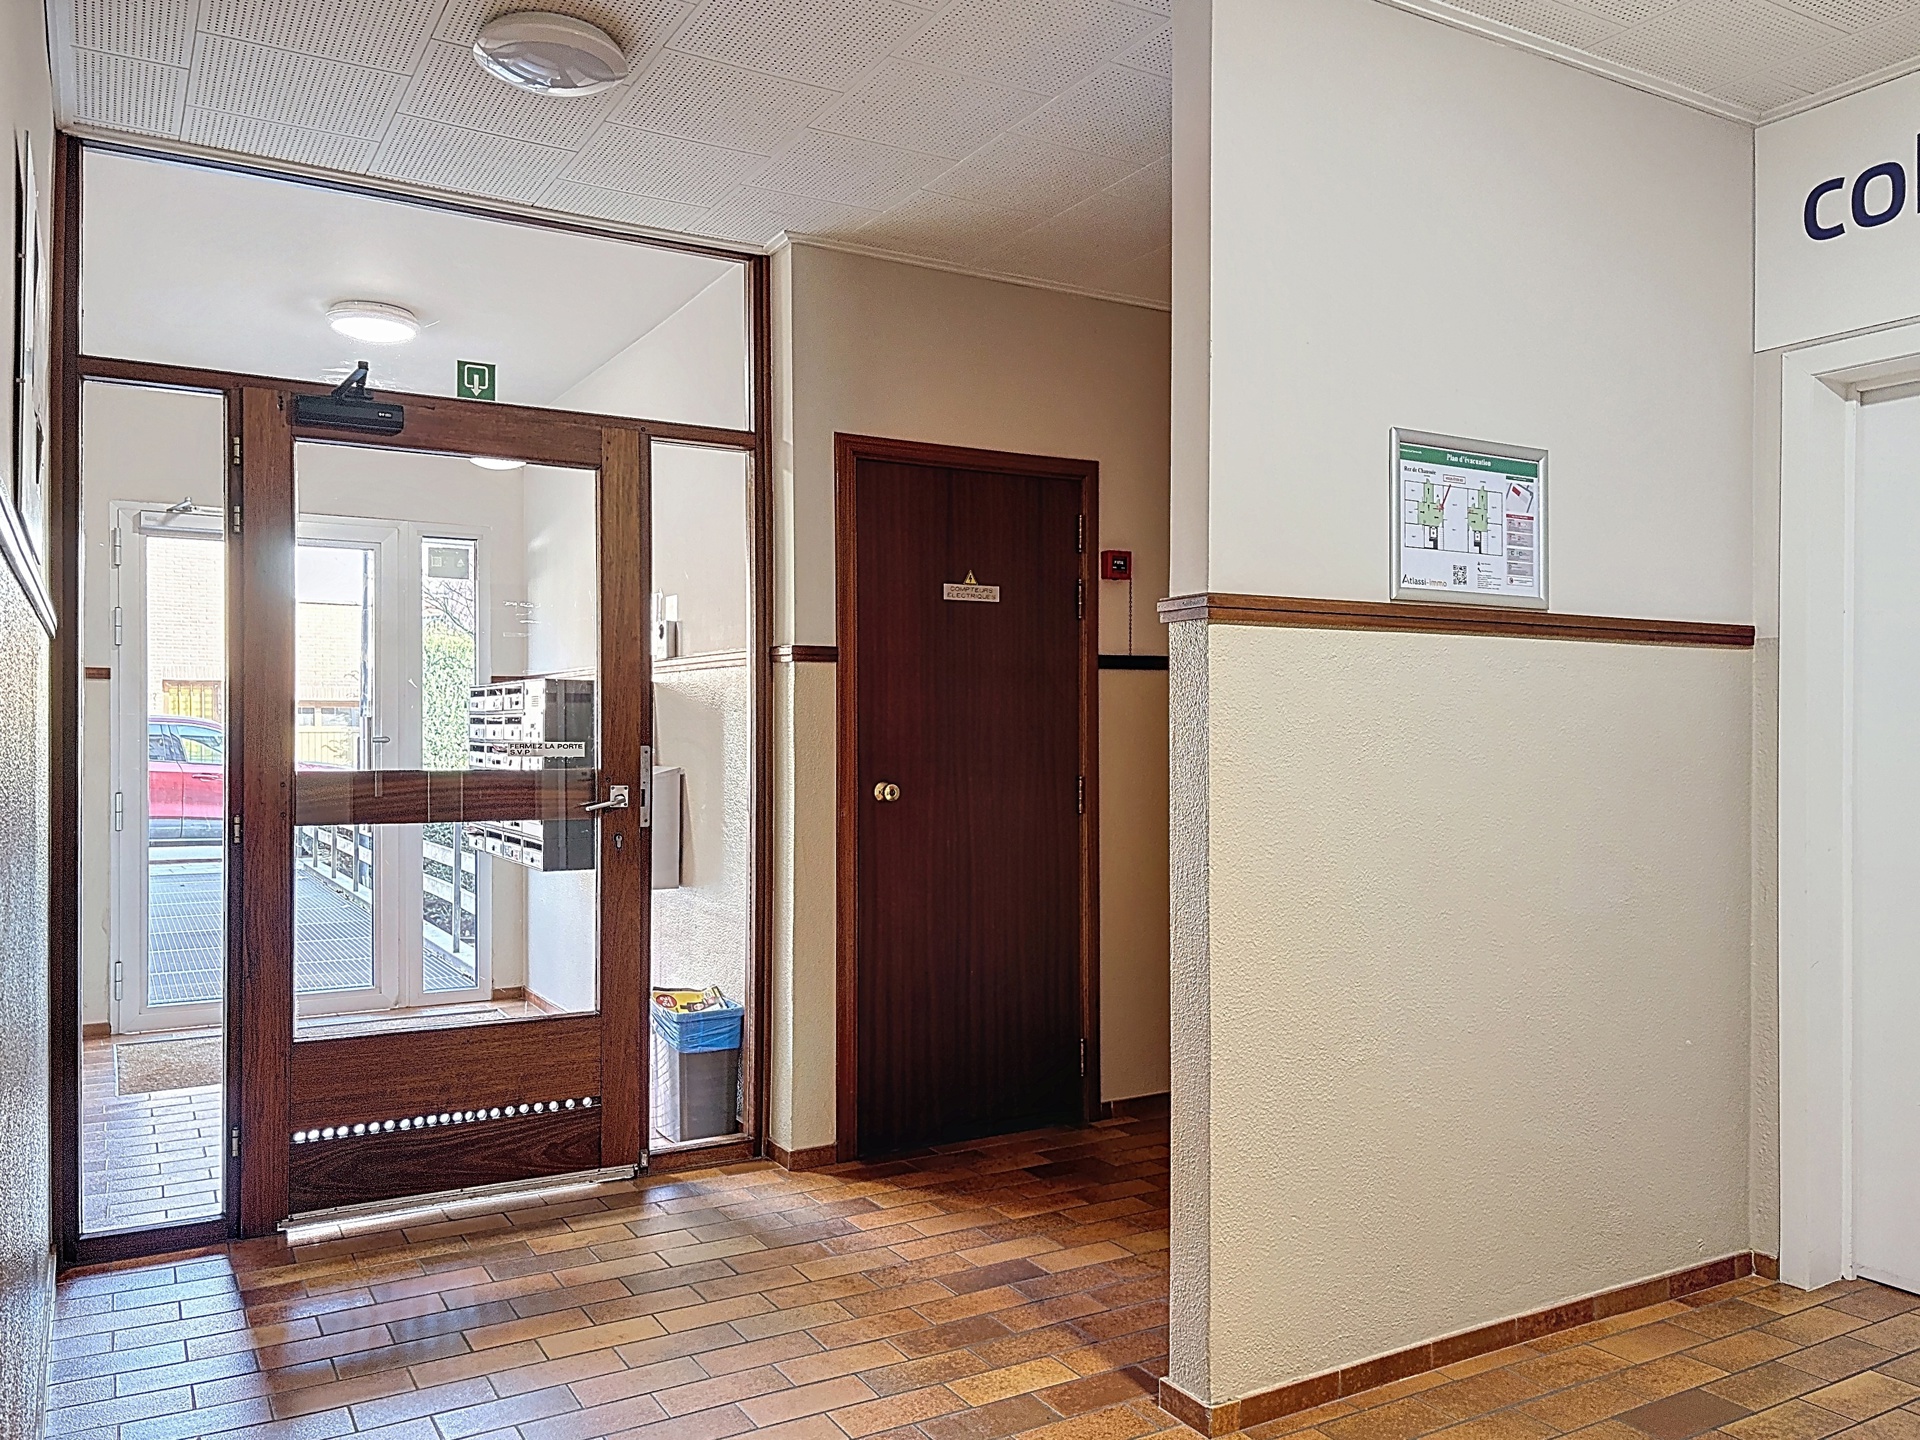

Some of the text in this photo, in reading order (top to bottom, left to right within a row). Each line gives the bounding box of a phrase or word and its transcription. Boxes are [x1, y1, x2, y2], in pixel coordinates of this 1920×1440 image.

[1803, 133, 1920, 241] co
[1446, 453, 1459, 463] Plan
[950, 585, 993, 594] COMPTEURS
[947, 592, 996, 600] ELECTRIQUES
